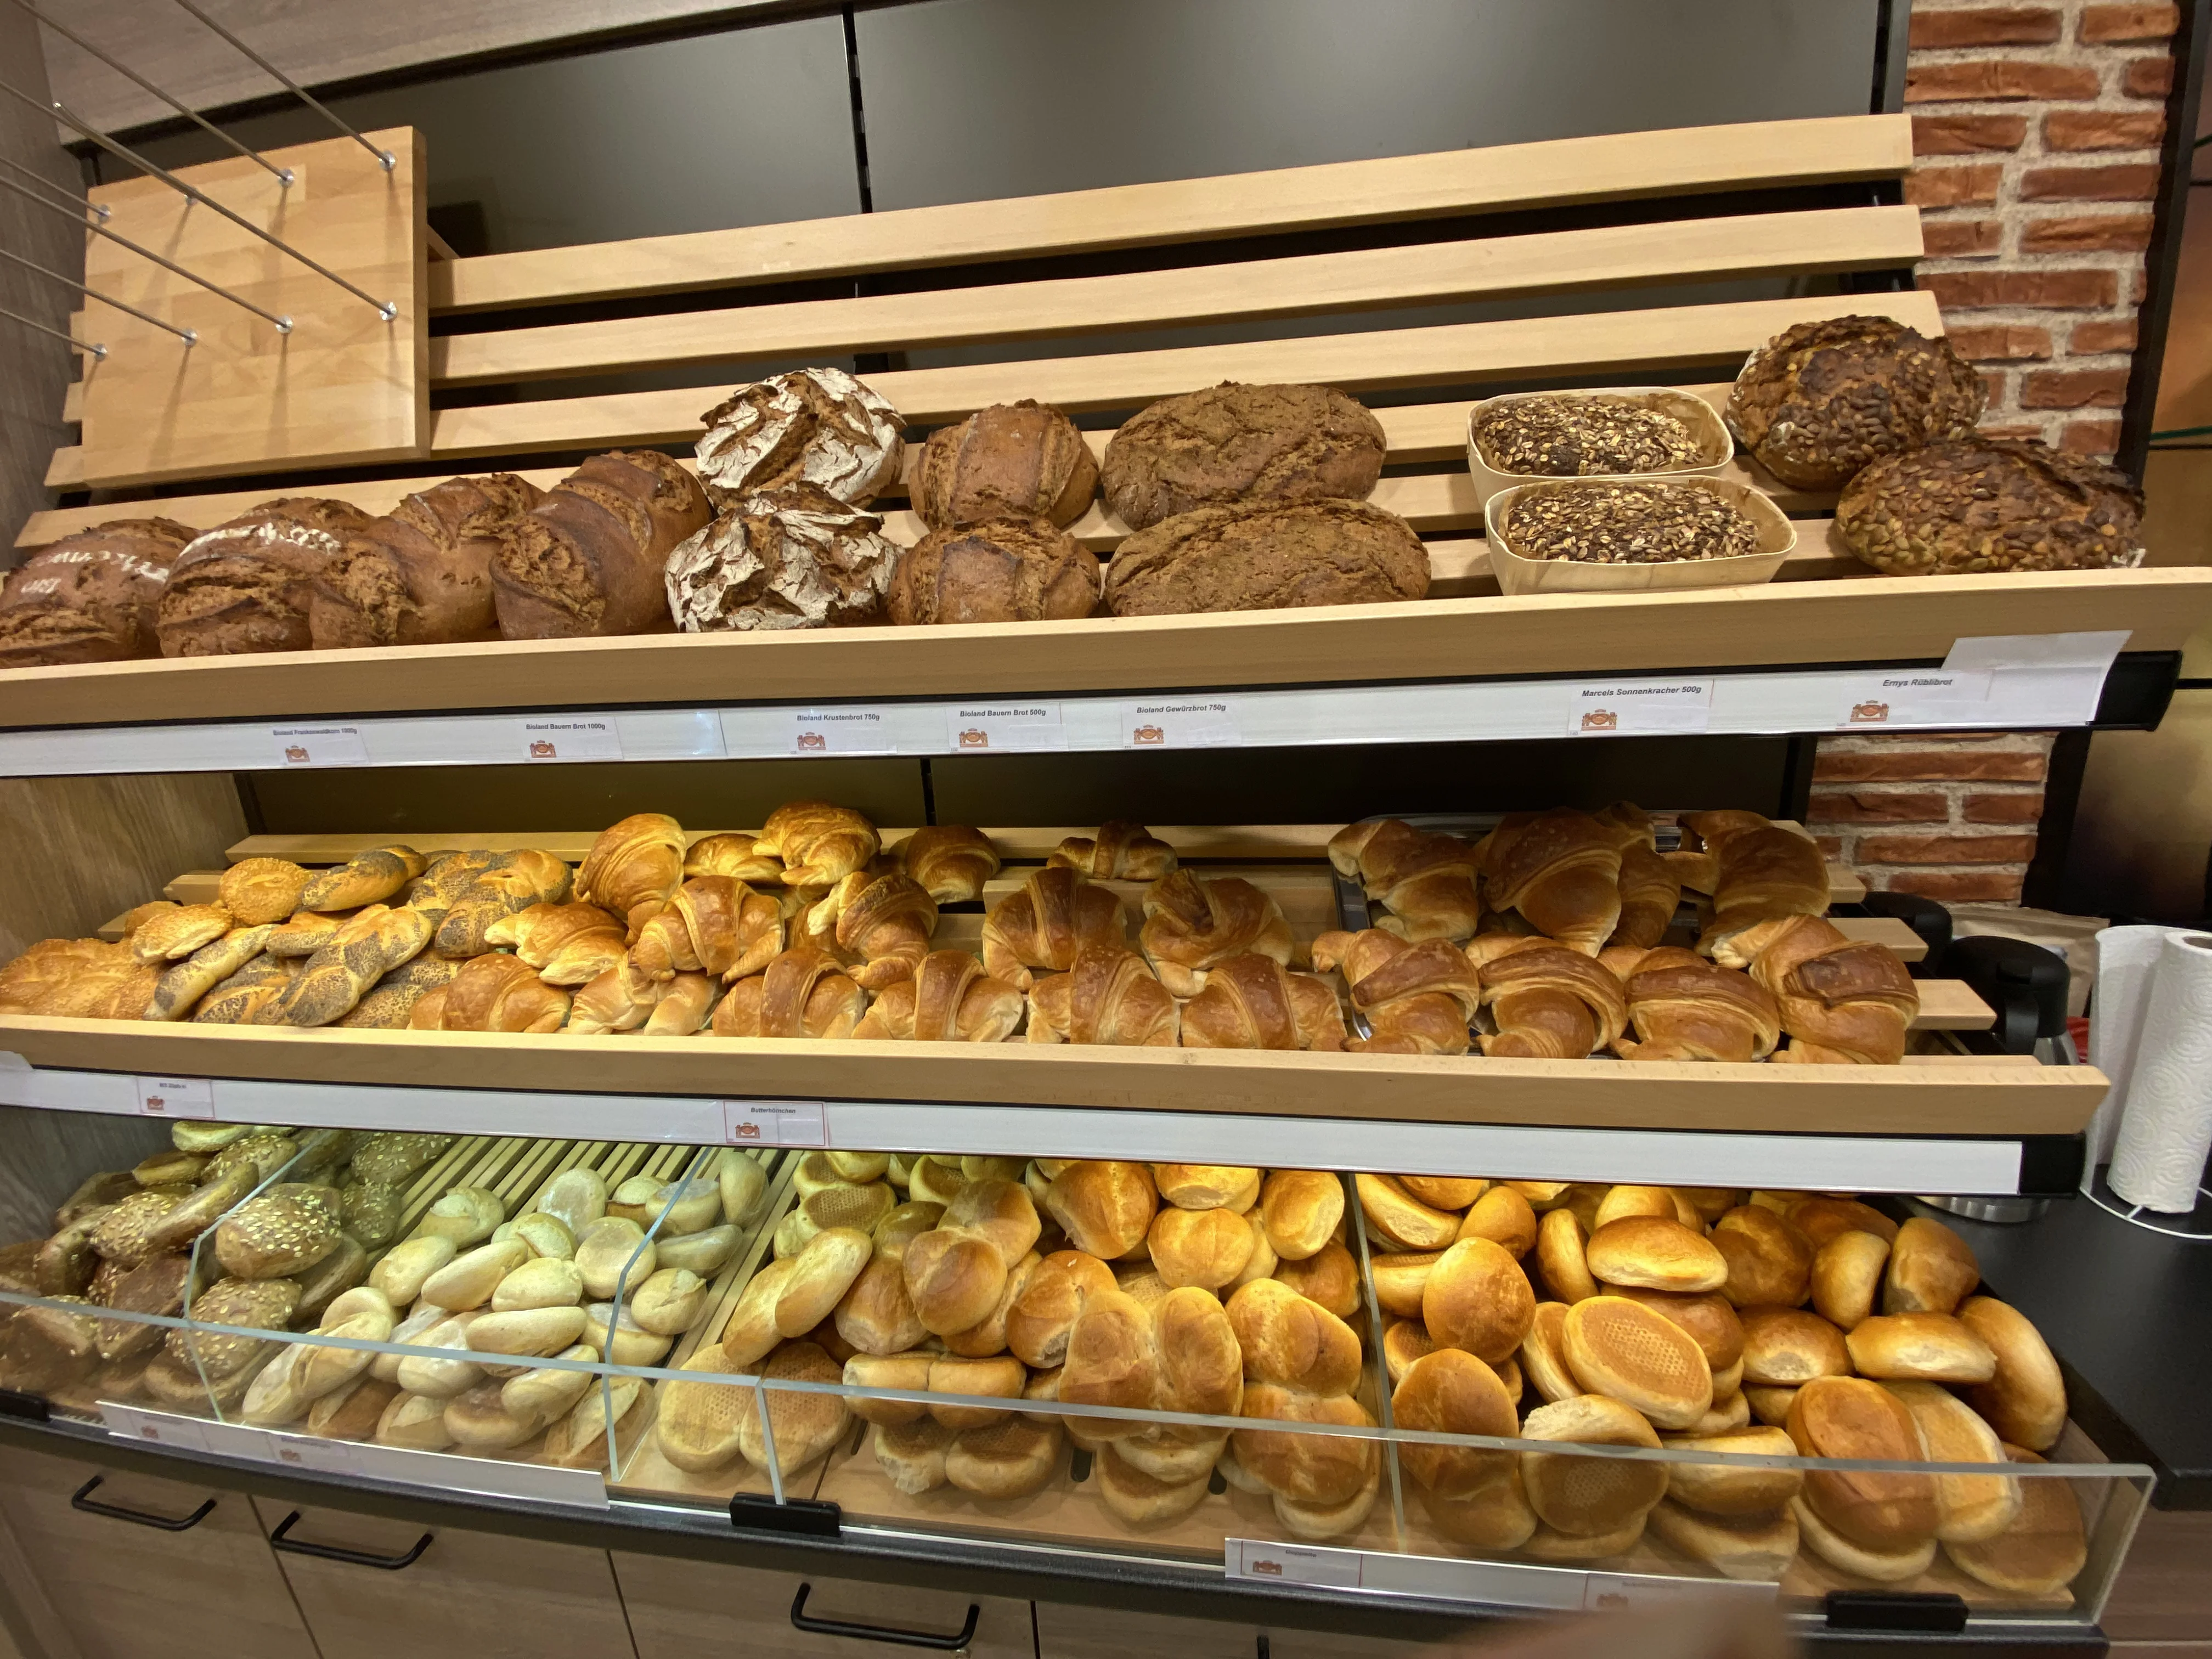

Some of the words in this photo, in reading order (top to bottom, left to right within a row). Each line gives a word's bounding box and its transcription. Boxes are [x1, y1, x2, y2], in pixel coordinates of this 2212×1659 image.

[1883, 679, 1908, 687] Emys
[1616, 687, 1680, 696] Sonnenkracher
[1681, 686, 1701, 694] 500g
